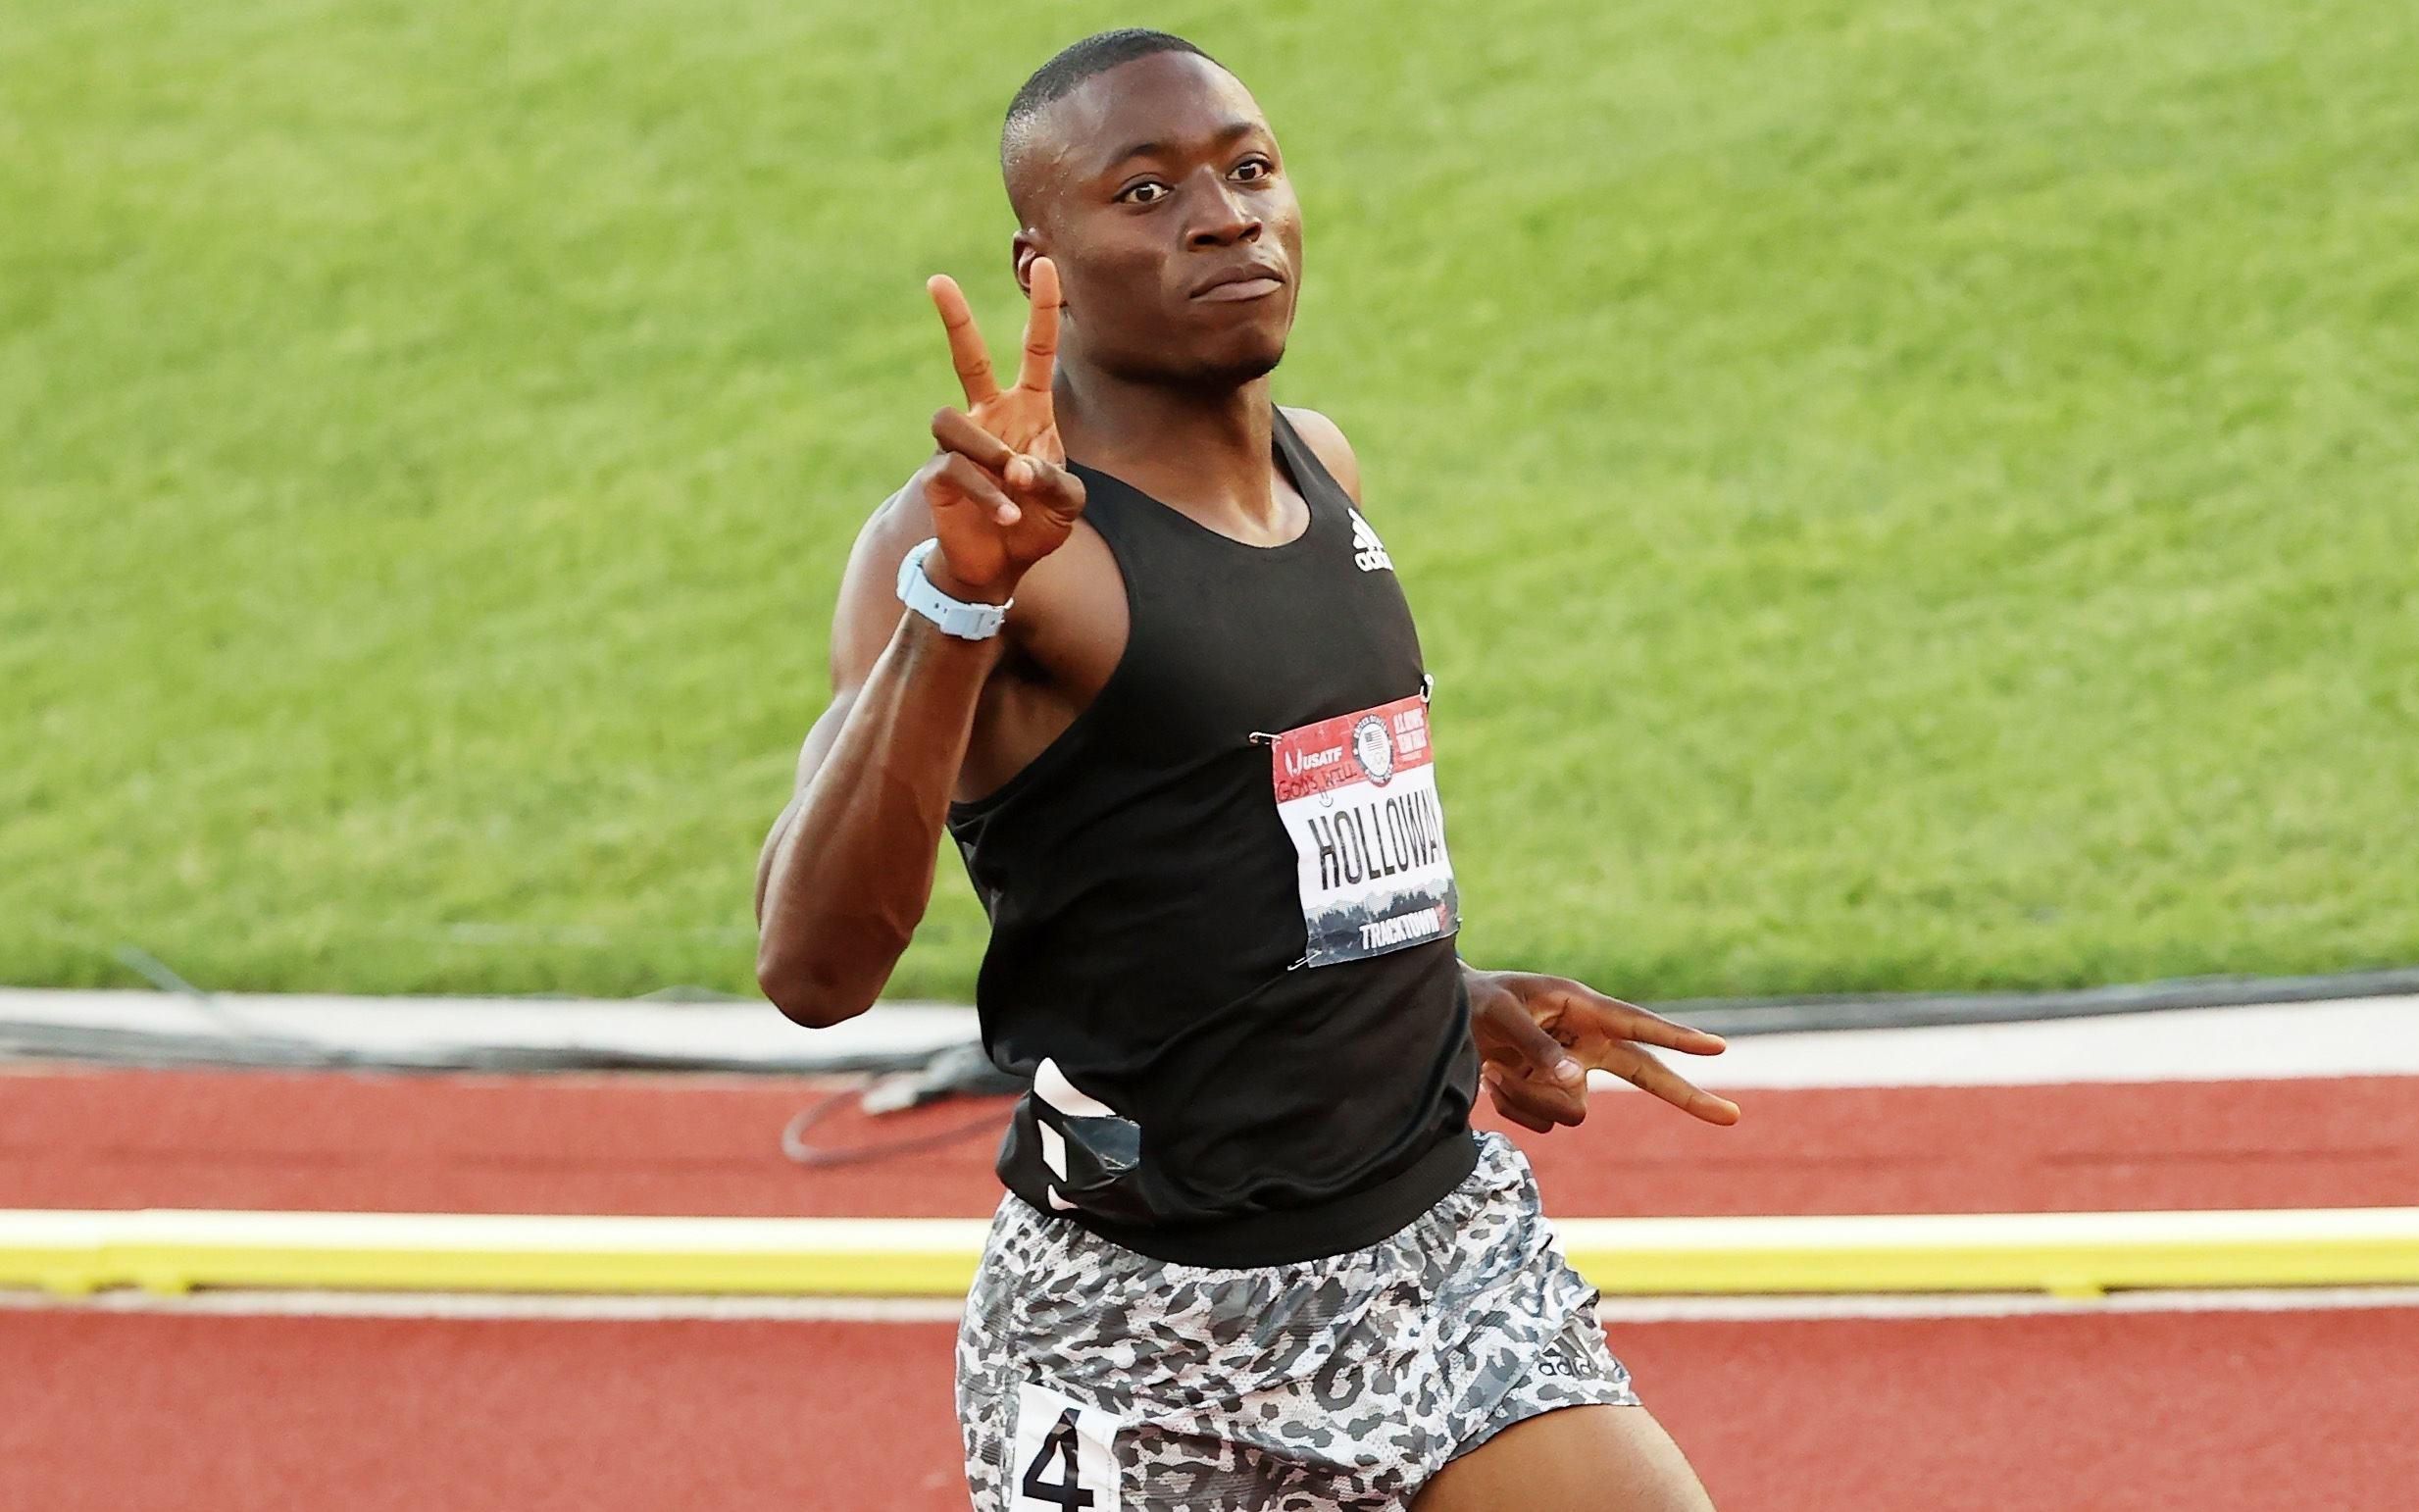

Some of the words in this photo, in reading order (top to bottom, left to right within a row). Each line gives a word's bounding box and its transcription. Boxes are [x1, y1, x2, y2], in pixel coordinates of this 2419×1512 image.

[1302, 746, 1343, 771] USATF
[1358, 907, 1440, 950] TRACKTOWN
[1023, 1407, 1094, 1512] 4
